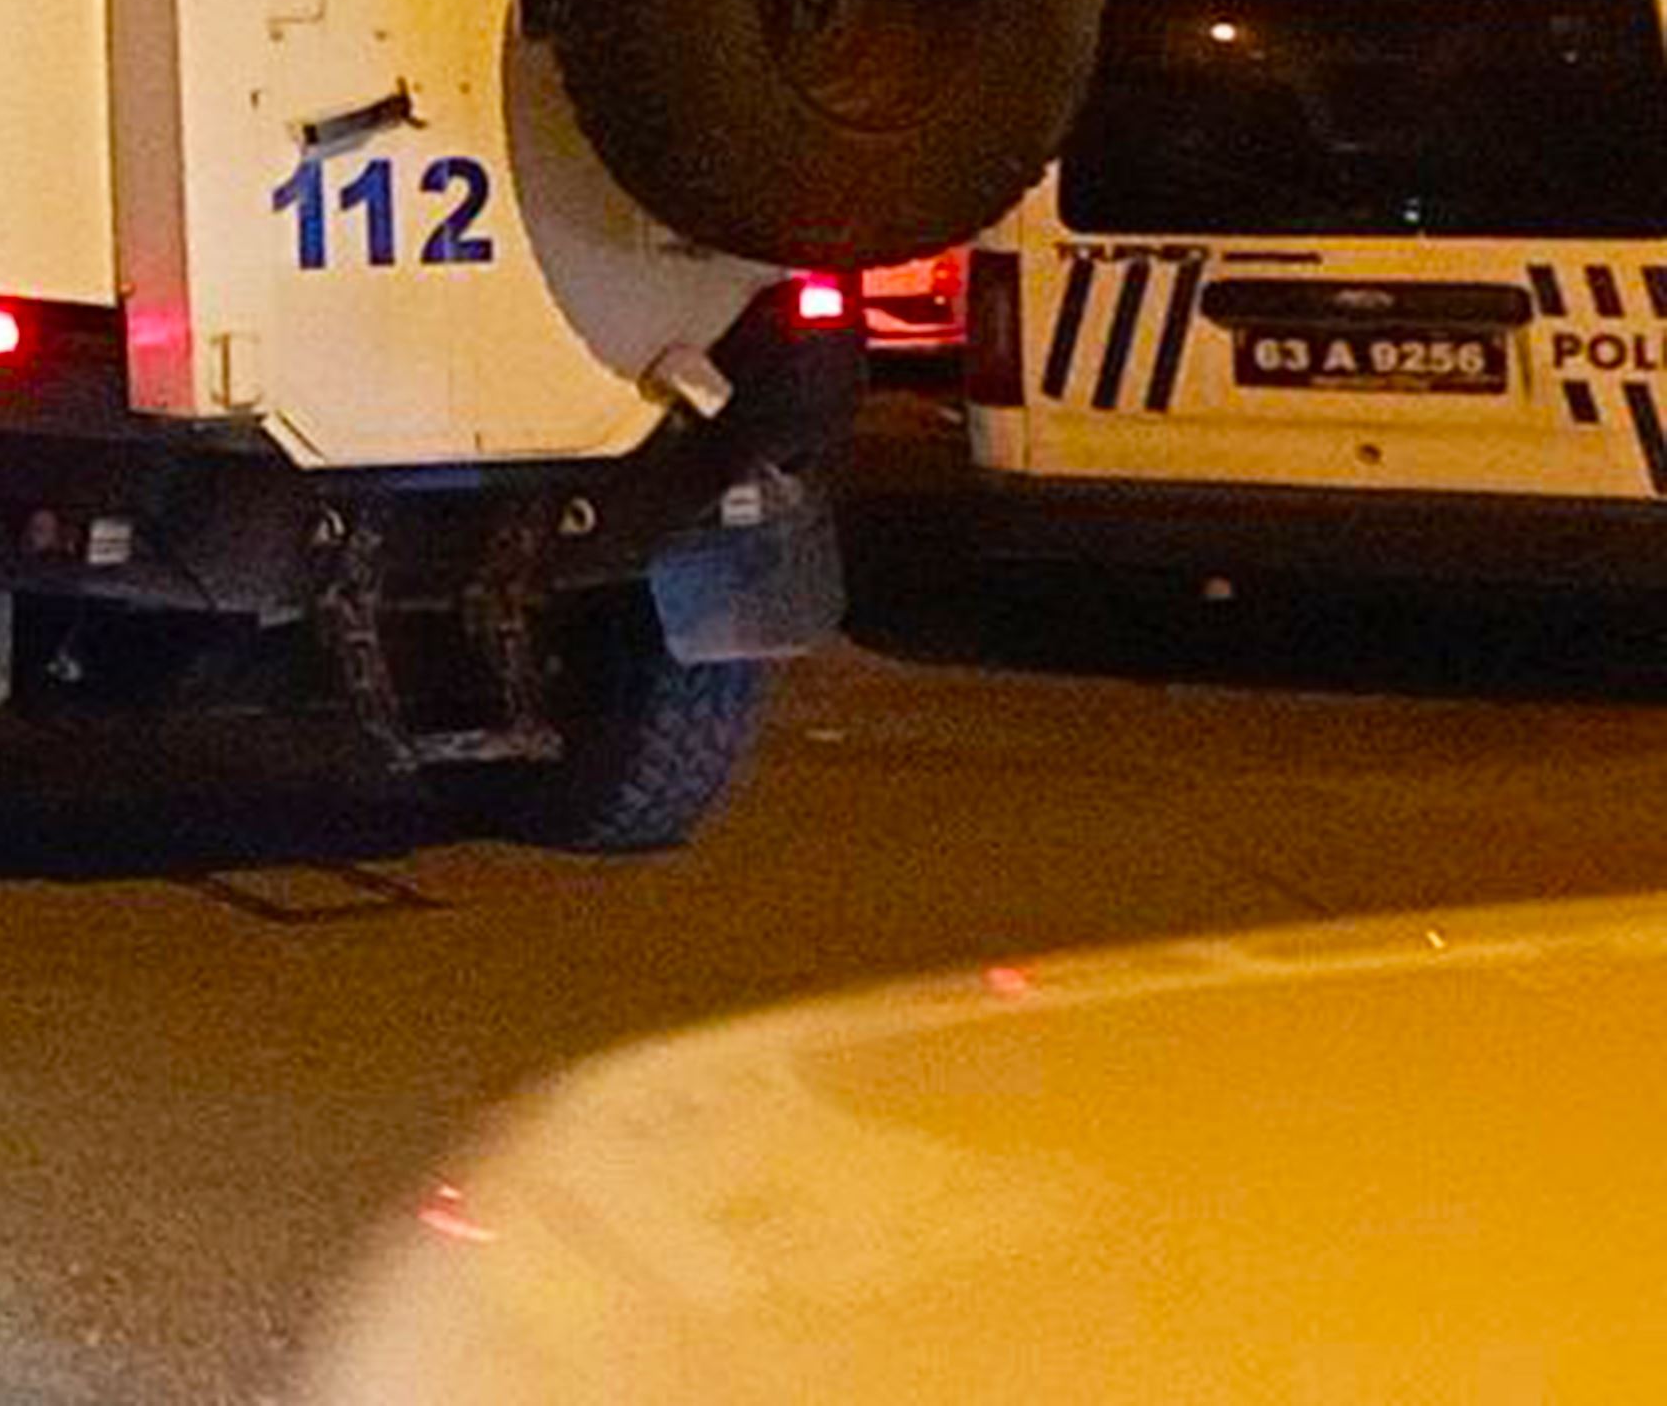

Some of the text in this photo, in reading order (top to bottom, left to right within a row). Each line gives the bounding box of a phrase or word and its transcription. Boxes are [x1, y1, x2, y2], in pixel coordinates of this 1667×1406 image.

[271, 154, 494, 271] 112
[1253, 338, 1487, 375] 63 A 9256
